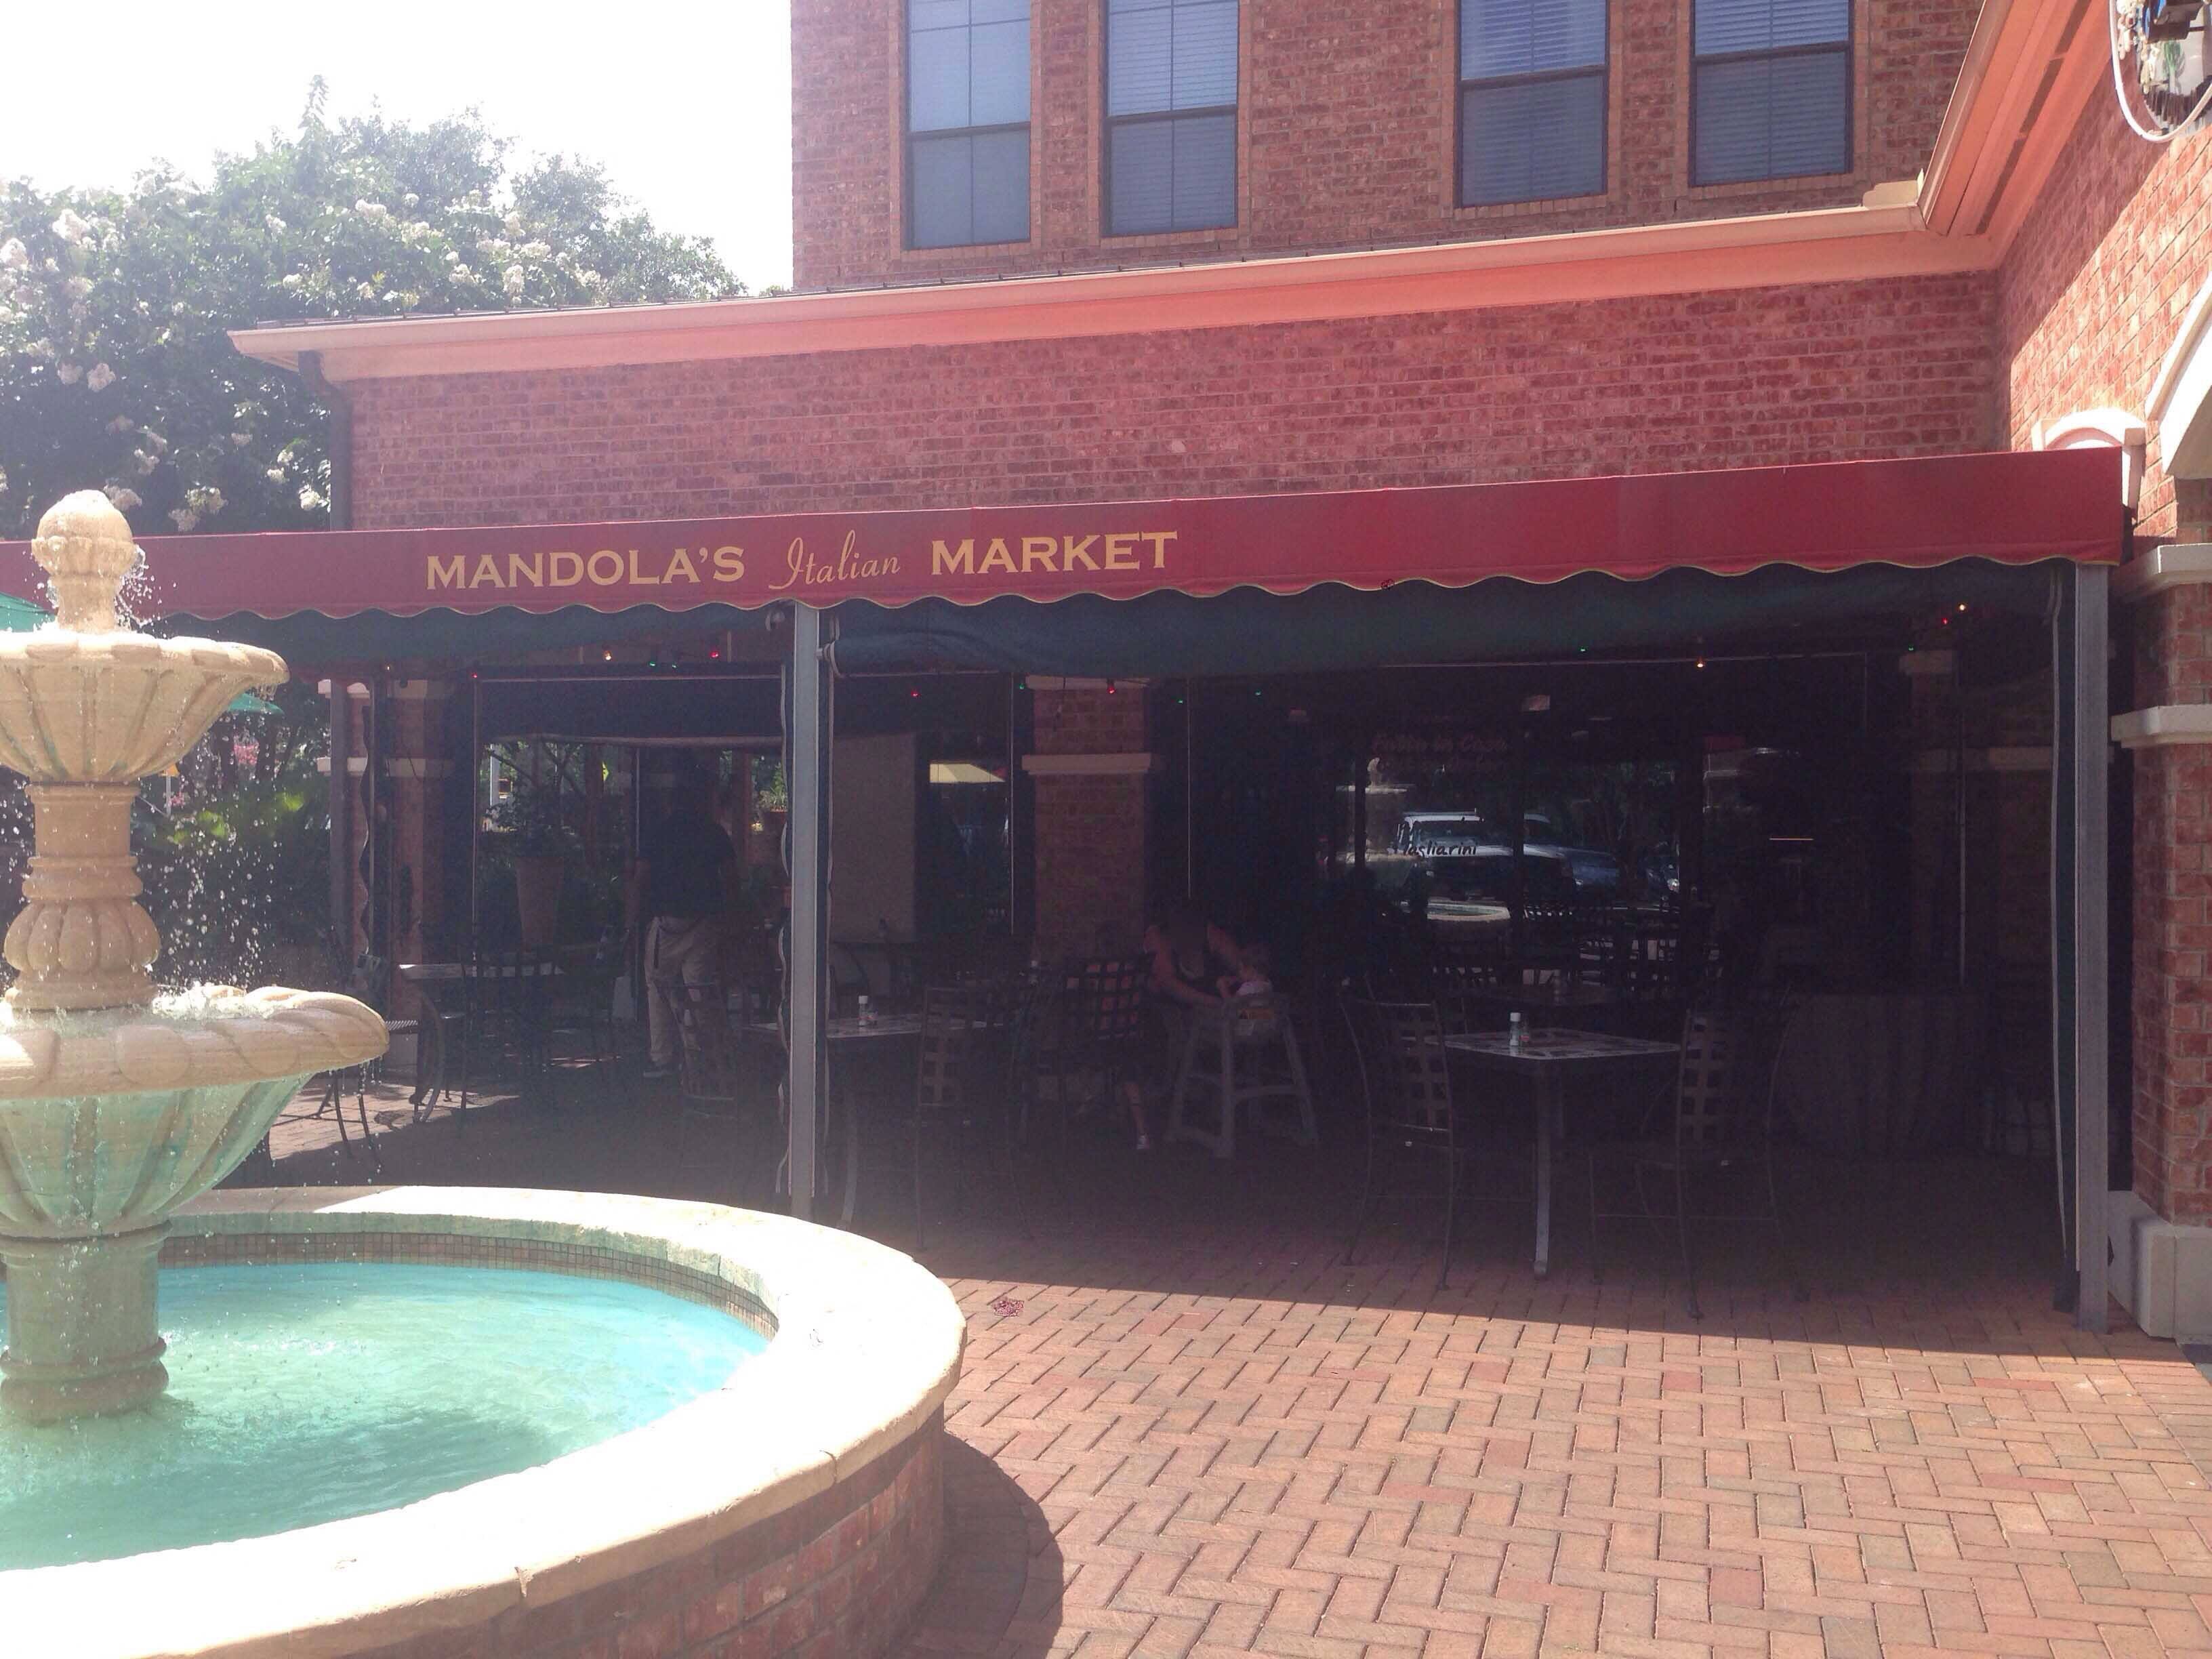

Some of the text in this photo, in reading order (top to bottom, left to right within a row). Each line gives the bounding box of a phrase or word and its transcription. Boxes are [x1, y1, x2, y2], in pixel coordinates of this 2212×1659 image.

[427, 529, 1179, 590] MANDOLA'S Italian MARKET
